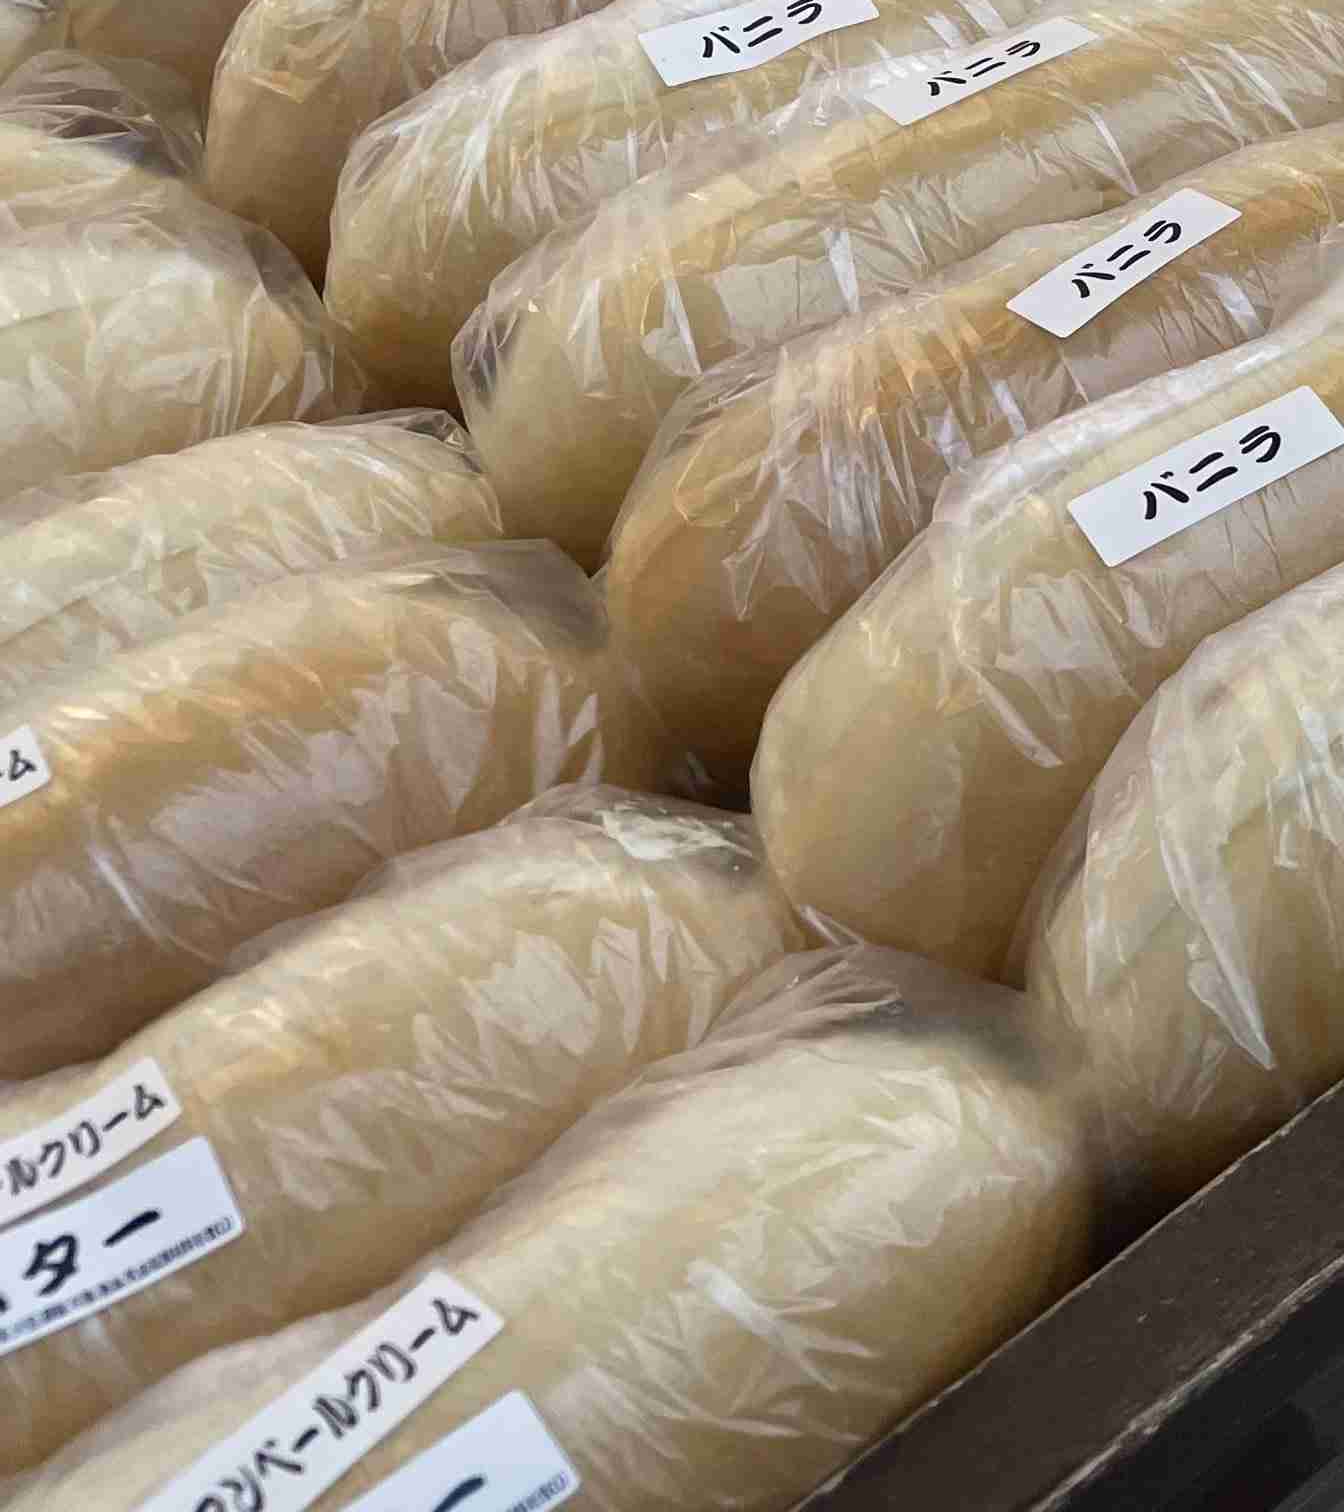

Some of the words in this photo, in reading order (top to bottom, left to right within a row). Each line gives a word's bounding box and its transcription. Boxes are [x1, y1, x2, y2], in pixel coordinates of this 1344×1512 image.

[927, 40, 1041, 97] バニラ
[1071, 219, 1183, 300] バニラ
[1143, 425, 1287, 520] バニラ
[0, 1084, 165, 1196] ルクリーム
[0, 1209, 163, 1314] ター
